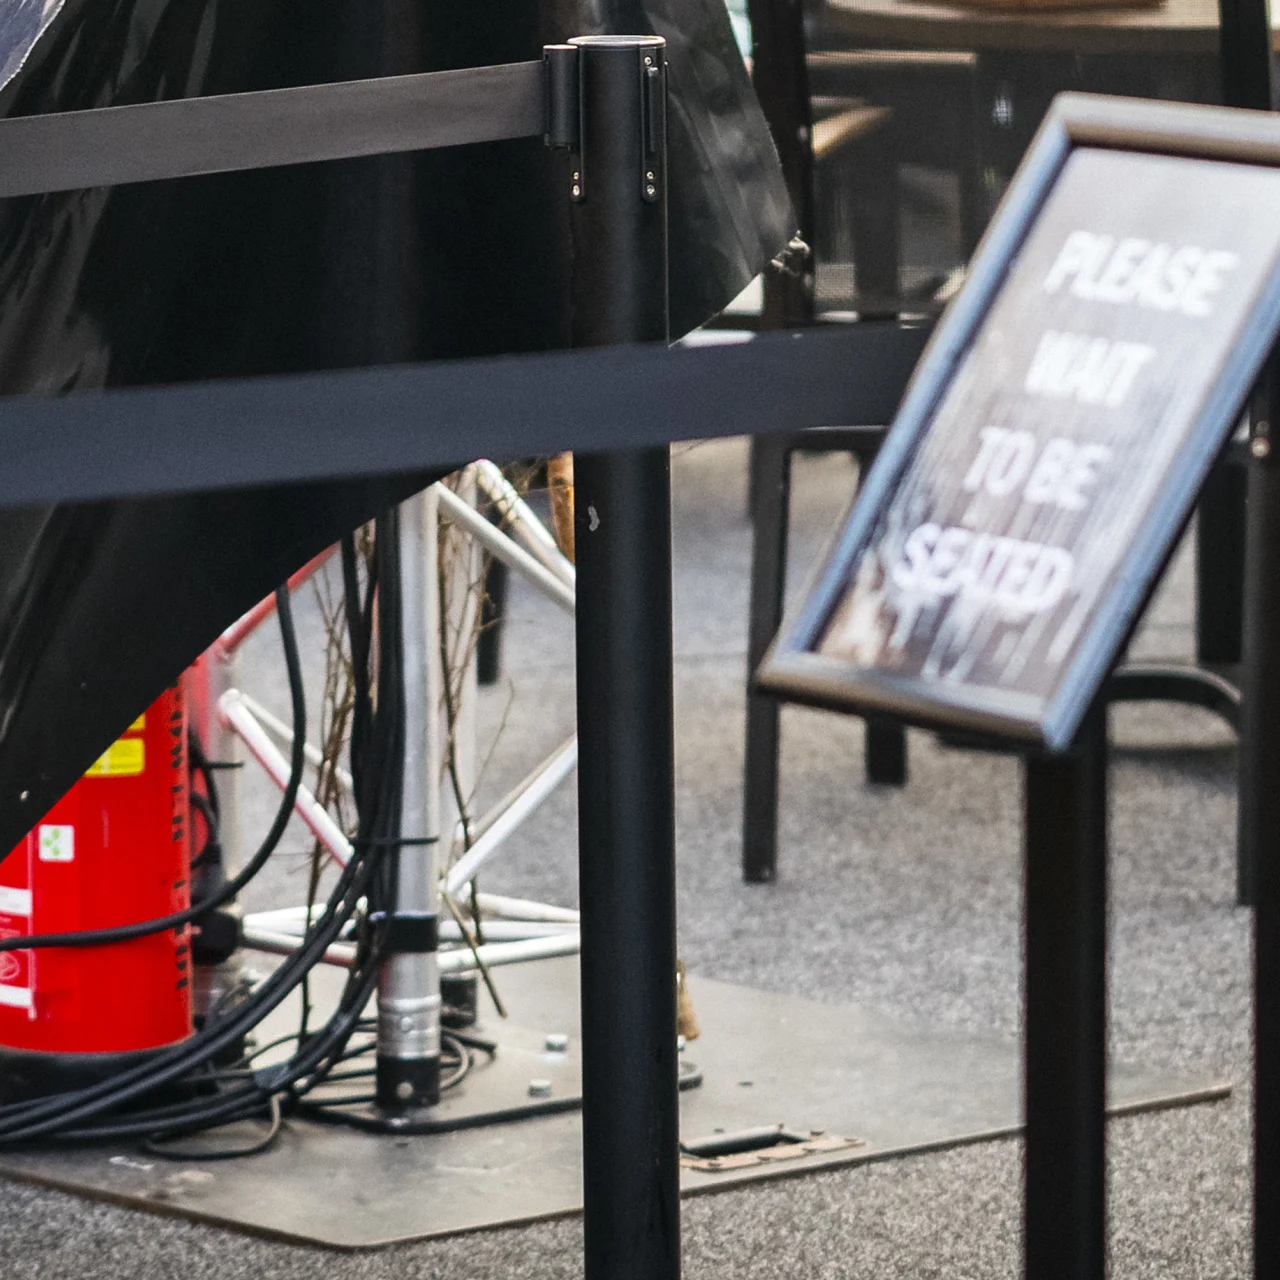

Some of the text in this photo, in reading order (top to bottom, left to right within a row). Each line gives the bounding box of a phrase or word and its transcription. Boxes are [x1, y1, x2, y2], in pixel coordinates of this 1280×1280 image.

[1044, 229, 1238, 318] PLEASE
[1026, 332, 1155, 409] WAIT
[964, 425, 1112, 512] TO BE
[891, 522, 1074, 615] SEATED
